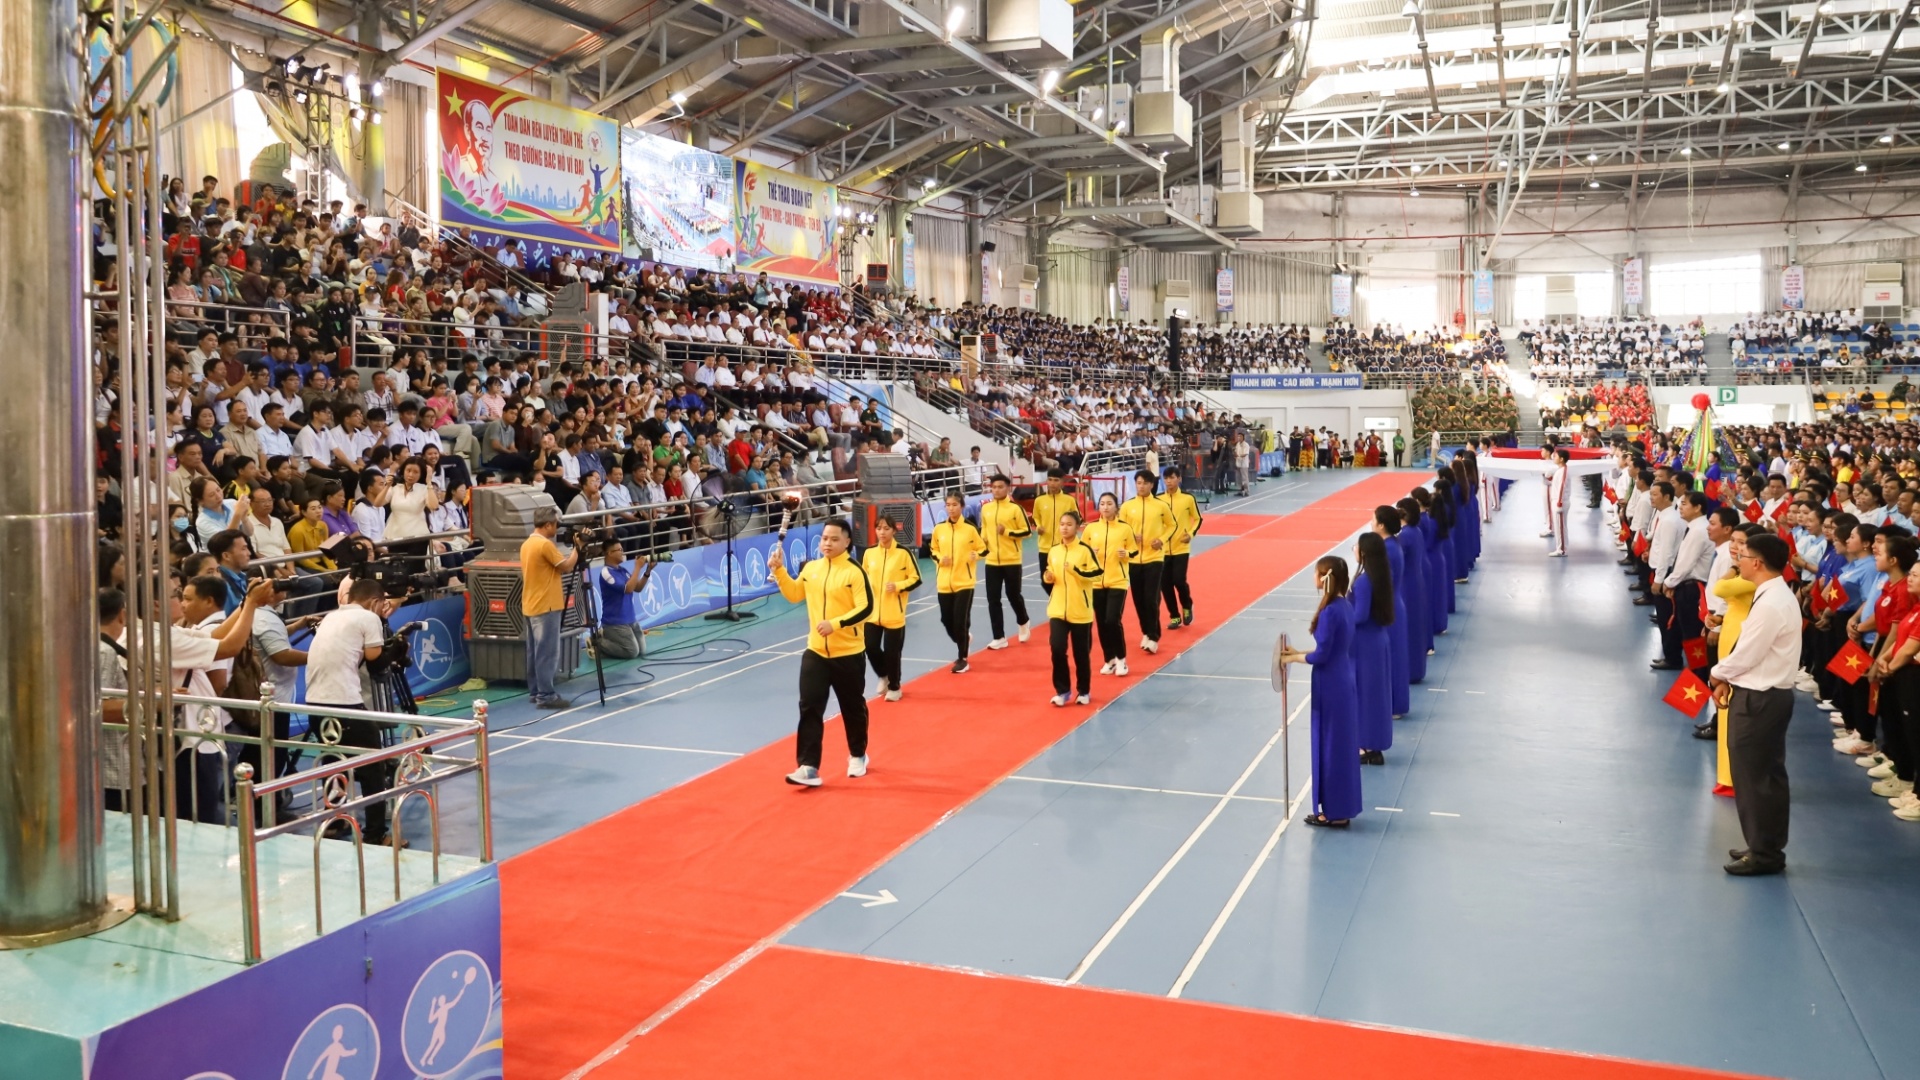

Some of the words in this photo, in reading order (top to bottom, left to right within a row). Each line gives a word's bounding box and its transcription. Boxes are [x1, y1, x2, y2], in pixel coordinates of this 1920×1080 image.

[503, 112, 518, 133] TOÀN
[519, 115, 531, 136] DÂN
[543, 123, 559, 146] LUYỆN
[504, 141, 520, 161] THEO
[543, 149, 556, 170] BÁC
[1233, 378, 1259, 387] NHANH
[1261, 377, 1276, 387] HƠN
[1283, 378, 1297, 387] CAO
[1299, 377, 1315, 386] HƠN
[1321, 378, 1342, 388] MẠNH
[1344, 377, 1359, 386] HƠN
[1722, 389, 1735, 402] D
